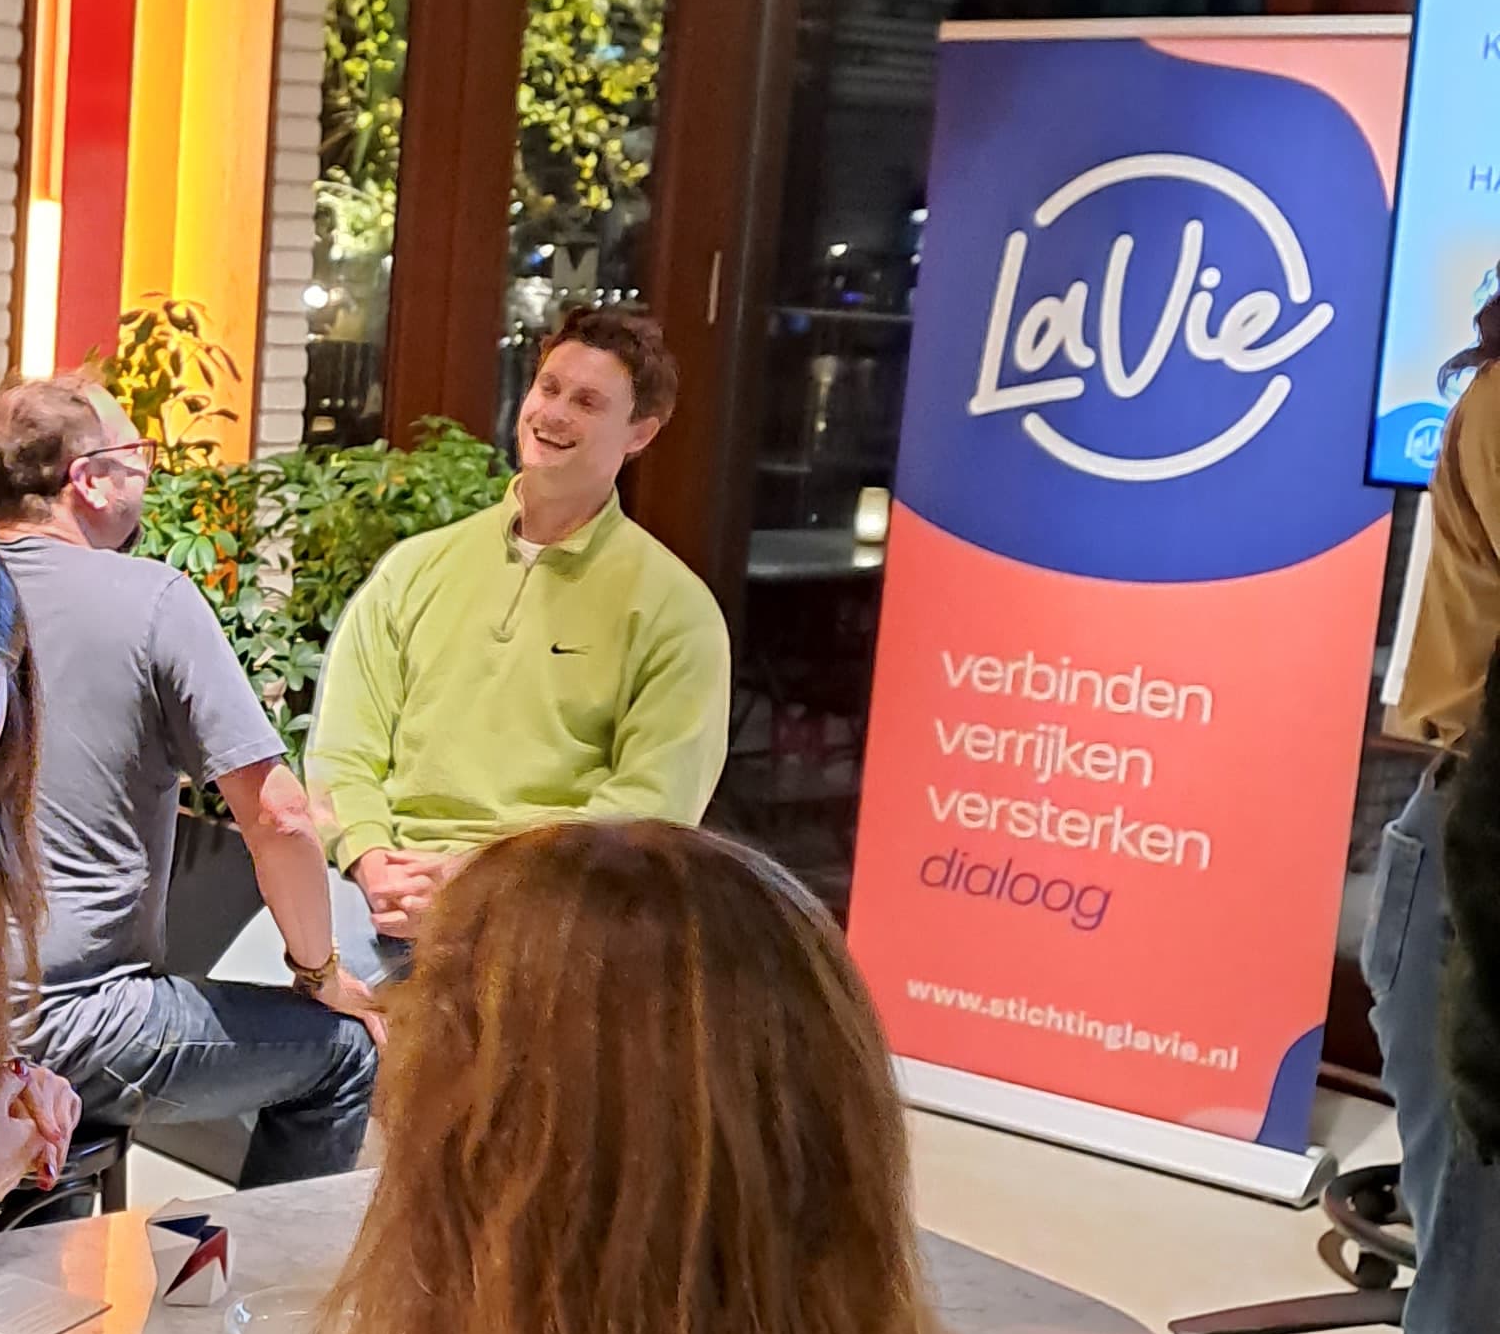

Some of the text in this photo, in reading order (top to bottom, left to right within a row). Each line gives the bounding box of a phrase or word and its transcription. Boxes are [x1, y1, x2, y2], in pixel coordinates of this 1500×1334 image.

[941, 650, 1214, 724] verbinden
[934, 719, 1153, 788] verrijken
[926, 784, 1211, 871] versterken
[918, 847, 1113, 932] dialoog
[906, 978, 1240, 1072] www.stichtinglavie.nl
